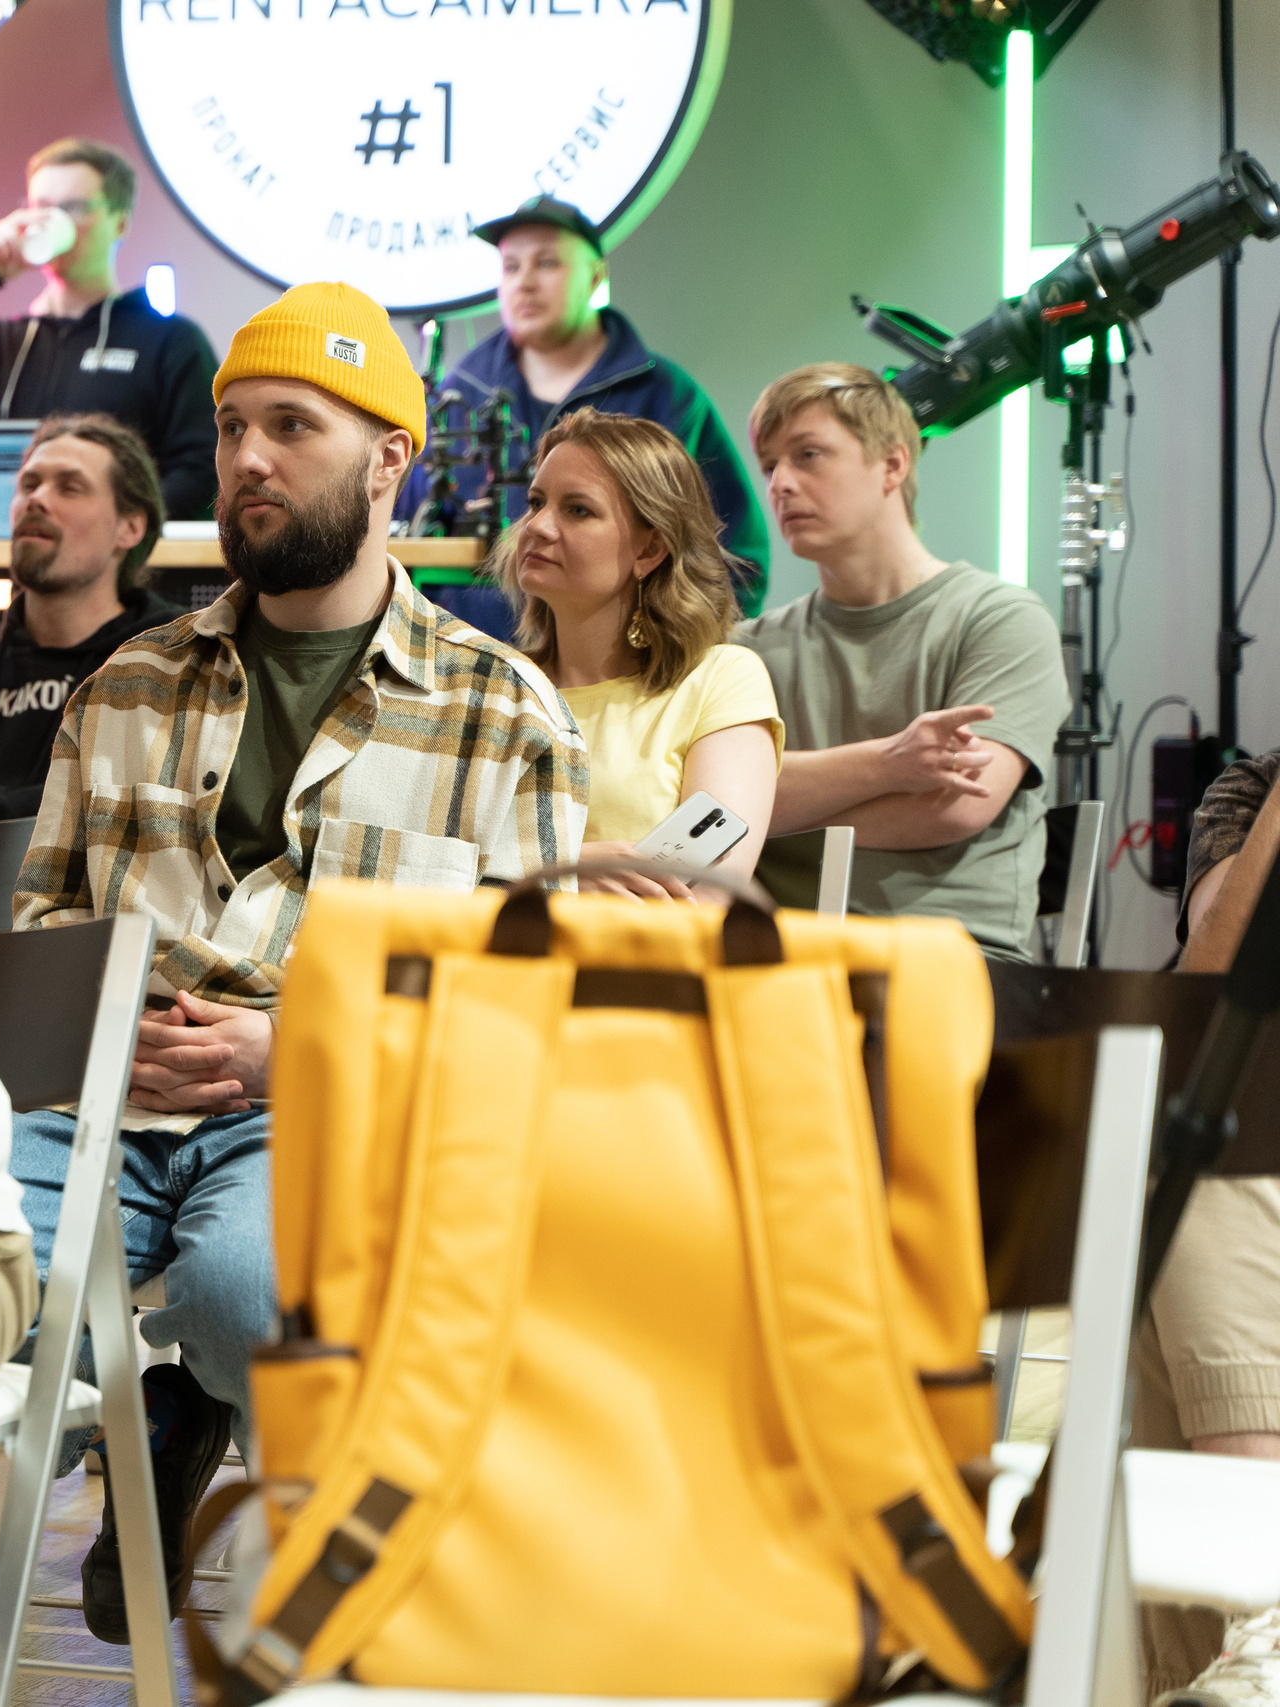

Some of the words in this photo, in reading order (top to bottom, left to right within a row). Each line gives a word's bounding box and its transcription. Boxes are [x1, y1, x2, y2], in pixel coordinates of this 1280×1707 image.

[192, 95, 277, 198] ПРОКАТ
[353, 80, 453, 167] #1
[533, 87, 625, 198] СЕРВИС
[333, 345, 358, 363] KUSTO
